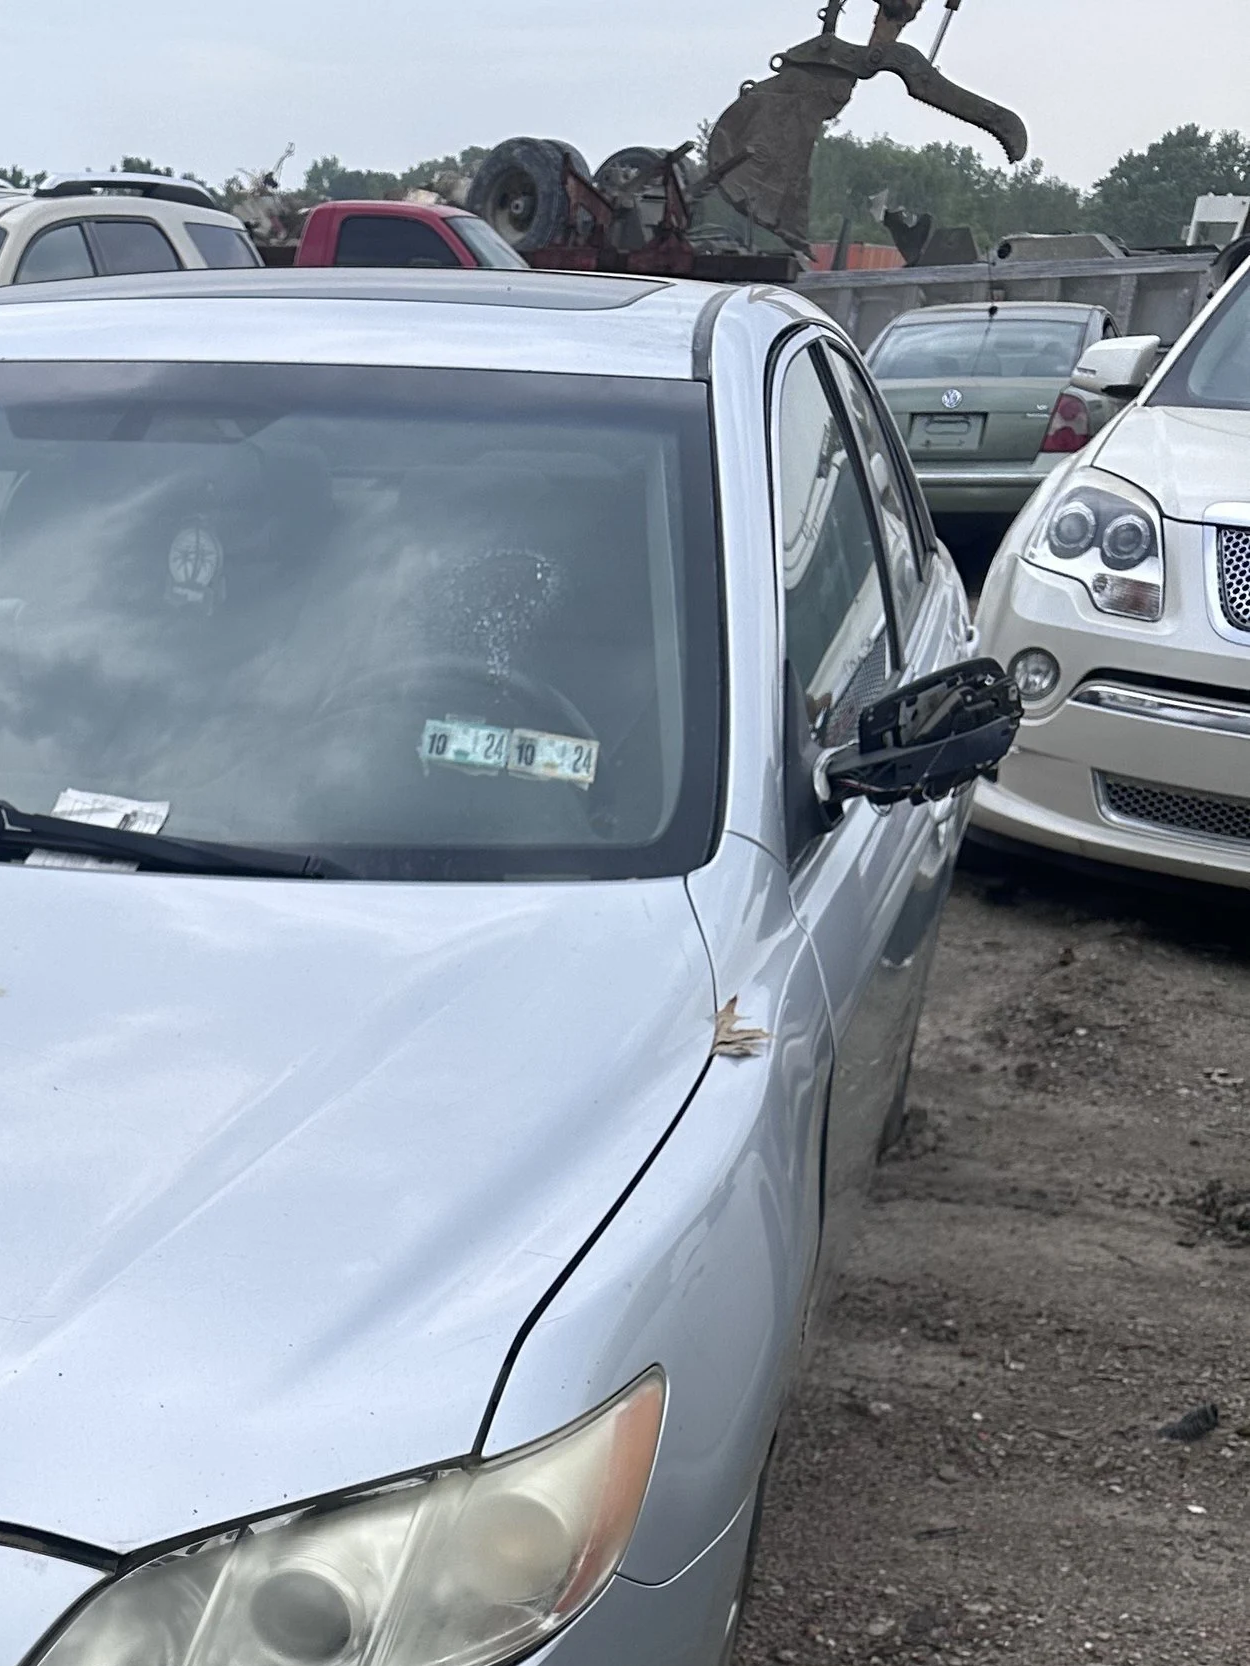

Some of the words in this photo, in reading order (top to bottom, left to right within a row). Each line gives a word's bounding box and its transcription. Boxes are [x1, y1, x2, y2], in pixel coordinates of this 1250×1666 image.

[428, 733, 448, 755] 10
[484, 733, 505, 760] 24
[517, 743, 536, 767] 10
[572, 745, 593, 775] 24
